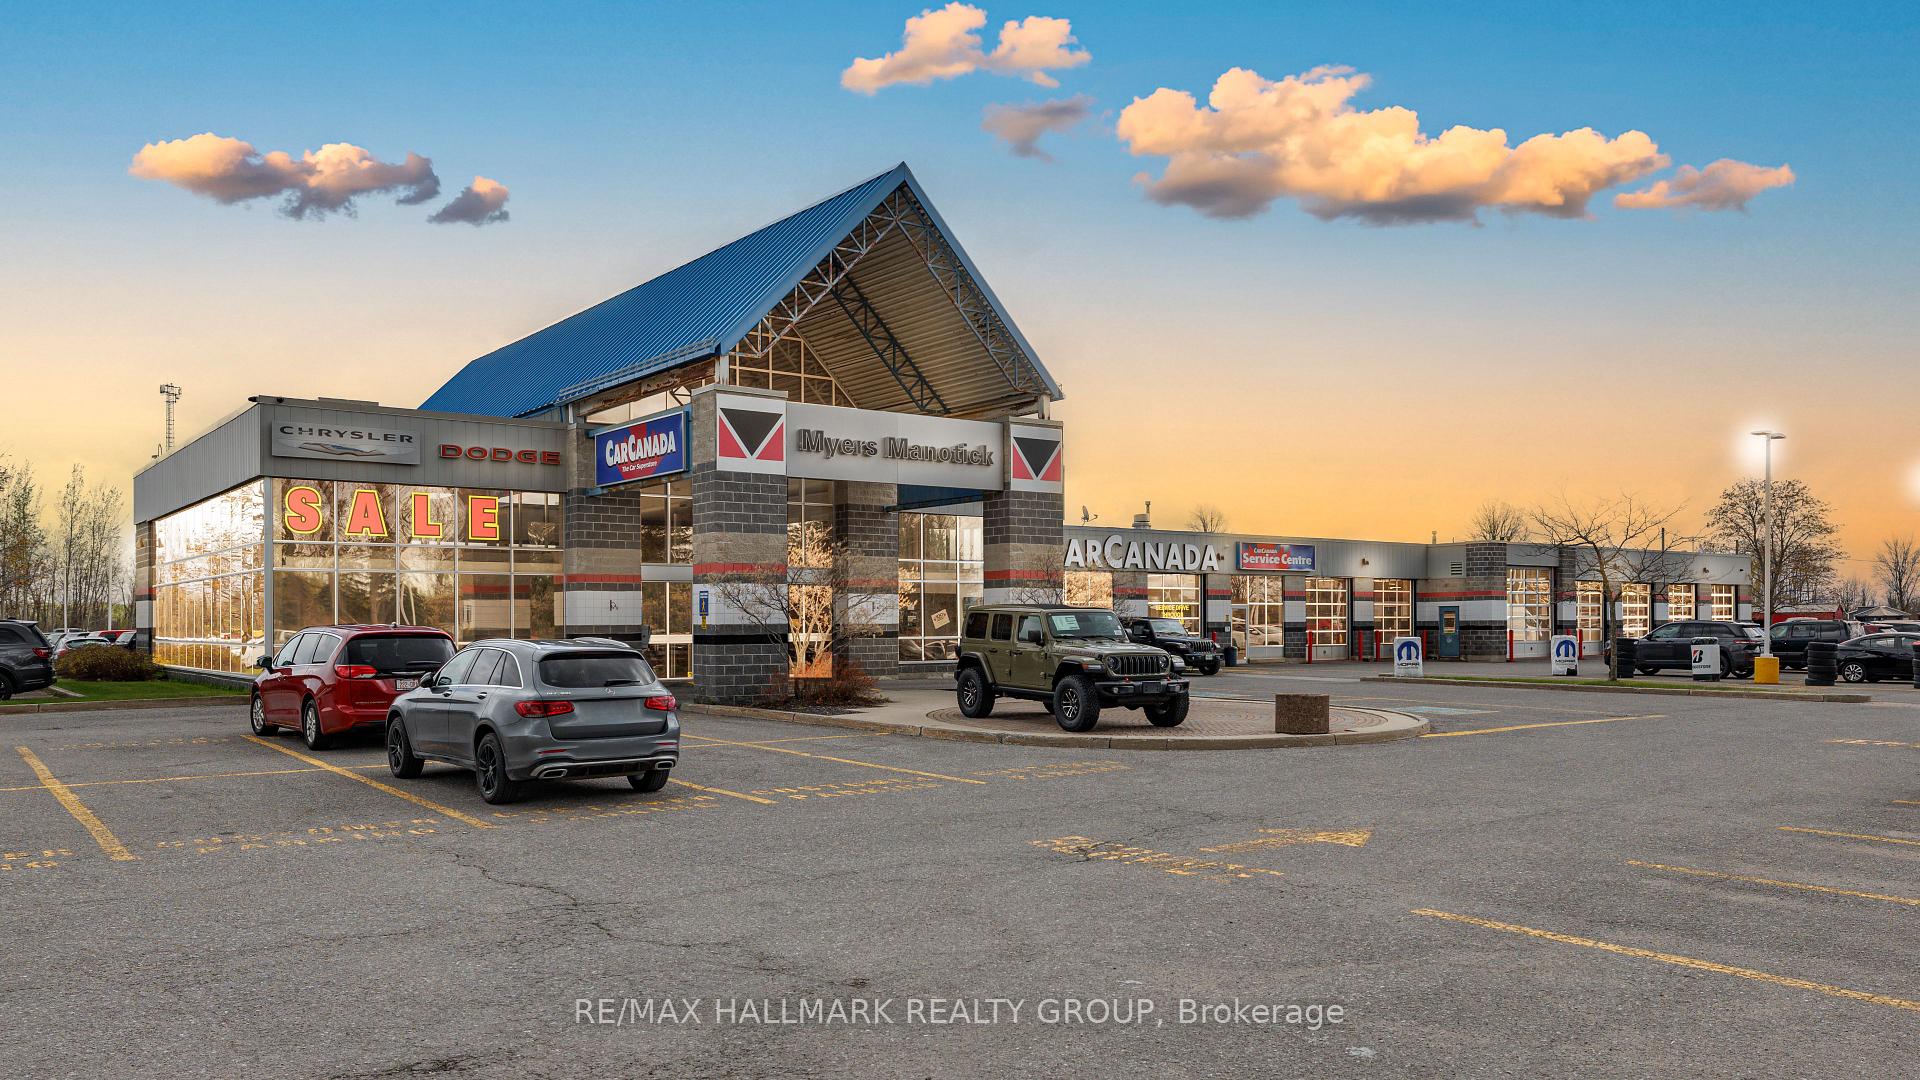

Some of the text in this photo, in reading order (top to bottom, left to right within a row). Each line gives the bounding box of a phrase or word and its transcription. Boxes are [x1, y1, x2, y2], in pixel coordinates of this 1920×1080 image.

[279, 425, 413, 443] CHRYSLER
[797, 428, 995, 467] Myers Manotick
[438, 443, 561, 465] DODGE
[285, 486, 500, 541] SALE
[1064, 534, 1220, 571] ARCANADA
[1243, 552, 1312, 566] Service Centre
